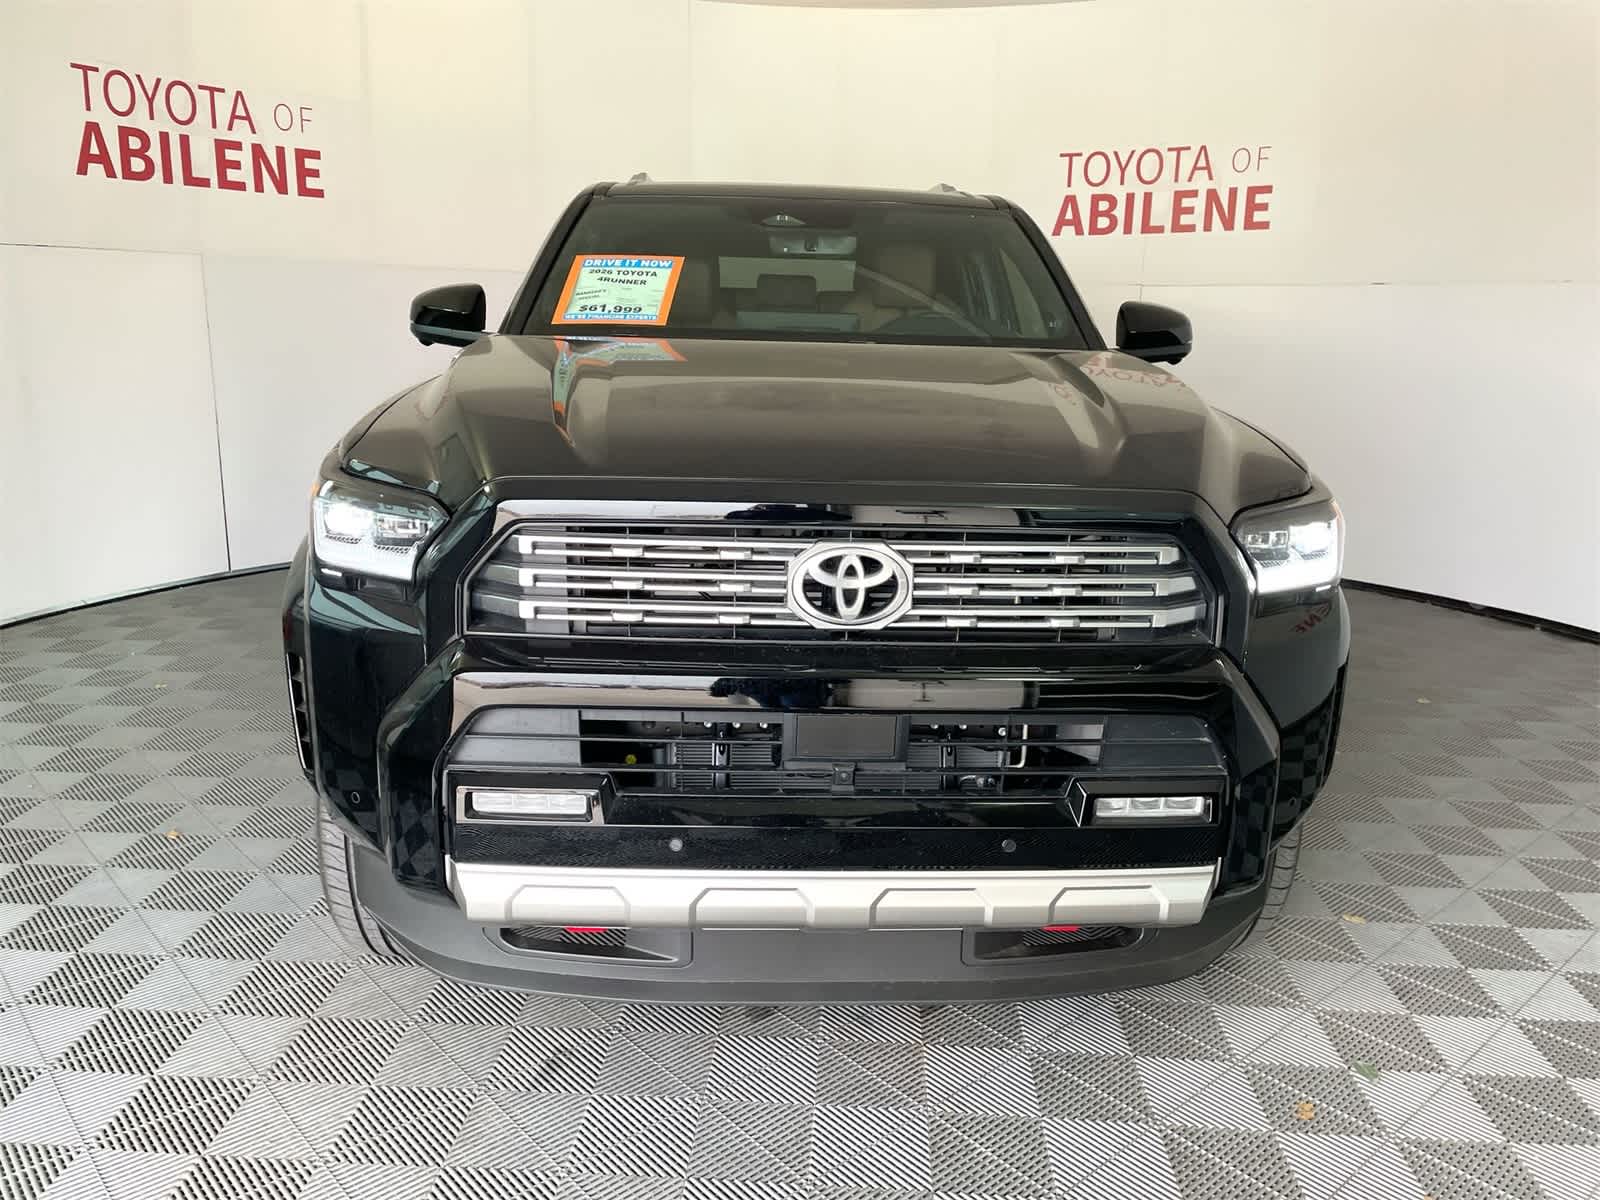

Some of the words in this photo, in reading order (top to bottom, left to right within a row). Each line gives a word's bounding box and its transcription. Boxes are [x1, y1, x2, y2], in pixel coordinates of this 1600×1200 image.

[70, 62, 257, 135] TOYOTA
[273, 103, 312, 133] OF
[76, 120, 325, 198] ABILENE
[1059, 145, 1214, 188] TOYOTA
[1231, 146, 1272, 174] OF
[1051, 185, 1274, 237] ABILENE
[583, 259, 623, 267] DRIVE
[624, 259, 639, 267] IT
[640, 260, 673, 268] NOW
[589, 268, 614, 276] 2026
[616, 269, 658, 278] TOYOTA
[596, 276, 648, 286] 4RUNNER
[578, 304, 643, 314] $61,999
